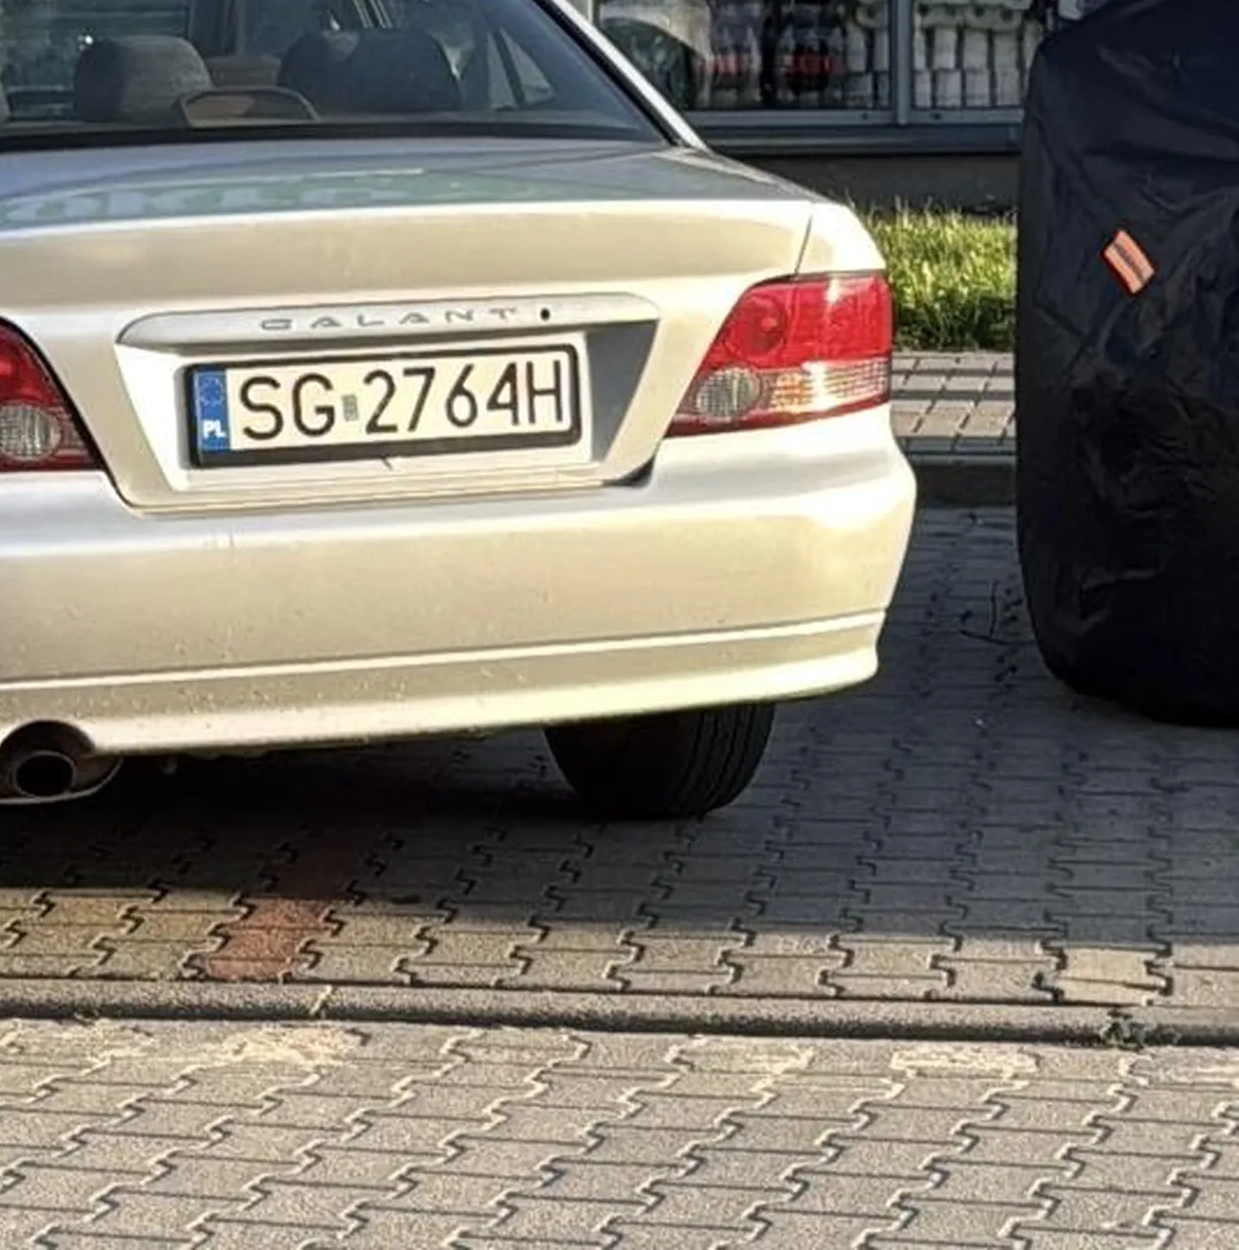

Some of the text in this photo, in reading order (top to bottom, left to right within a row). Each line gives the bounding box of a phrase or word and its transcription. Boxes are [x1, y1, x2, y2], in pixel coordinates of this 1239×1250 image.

[260, 306, 518, 332] GALANT
[239, 359, 564, 441] SG 2764H
[202, 419, 226, 439] PL
